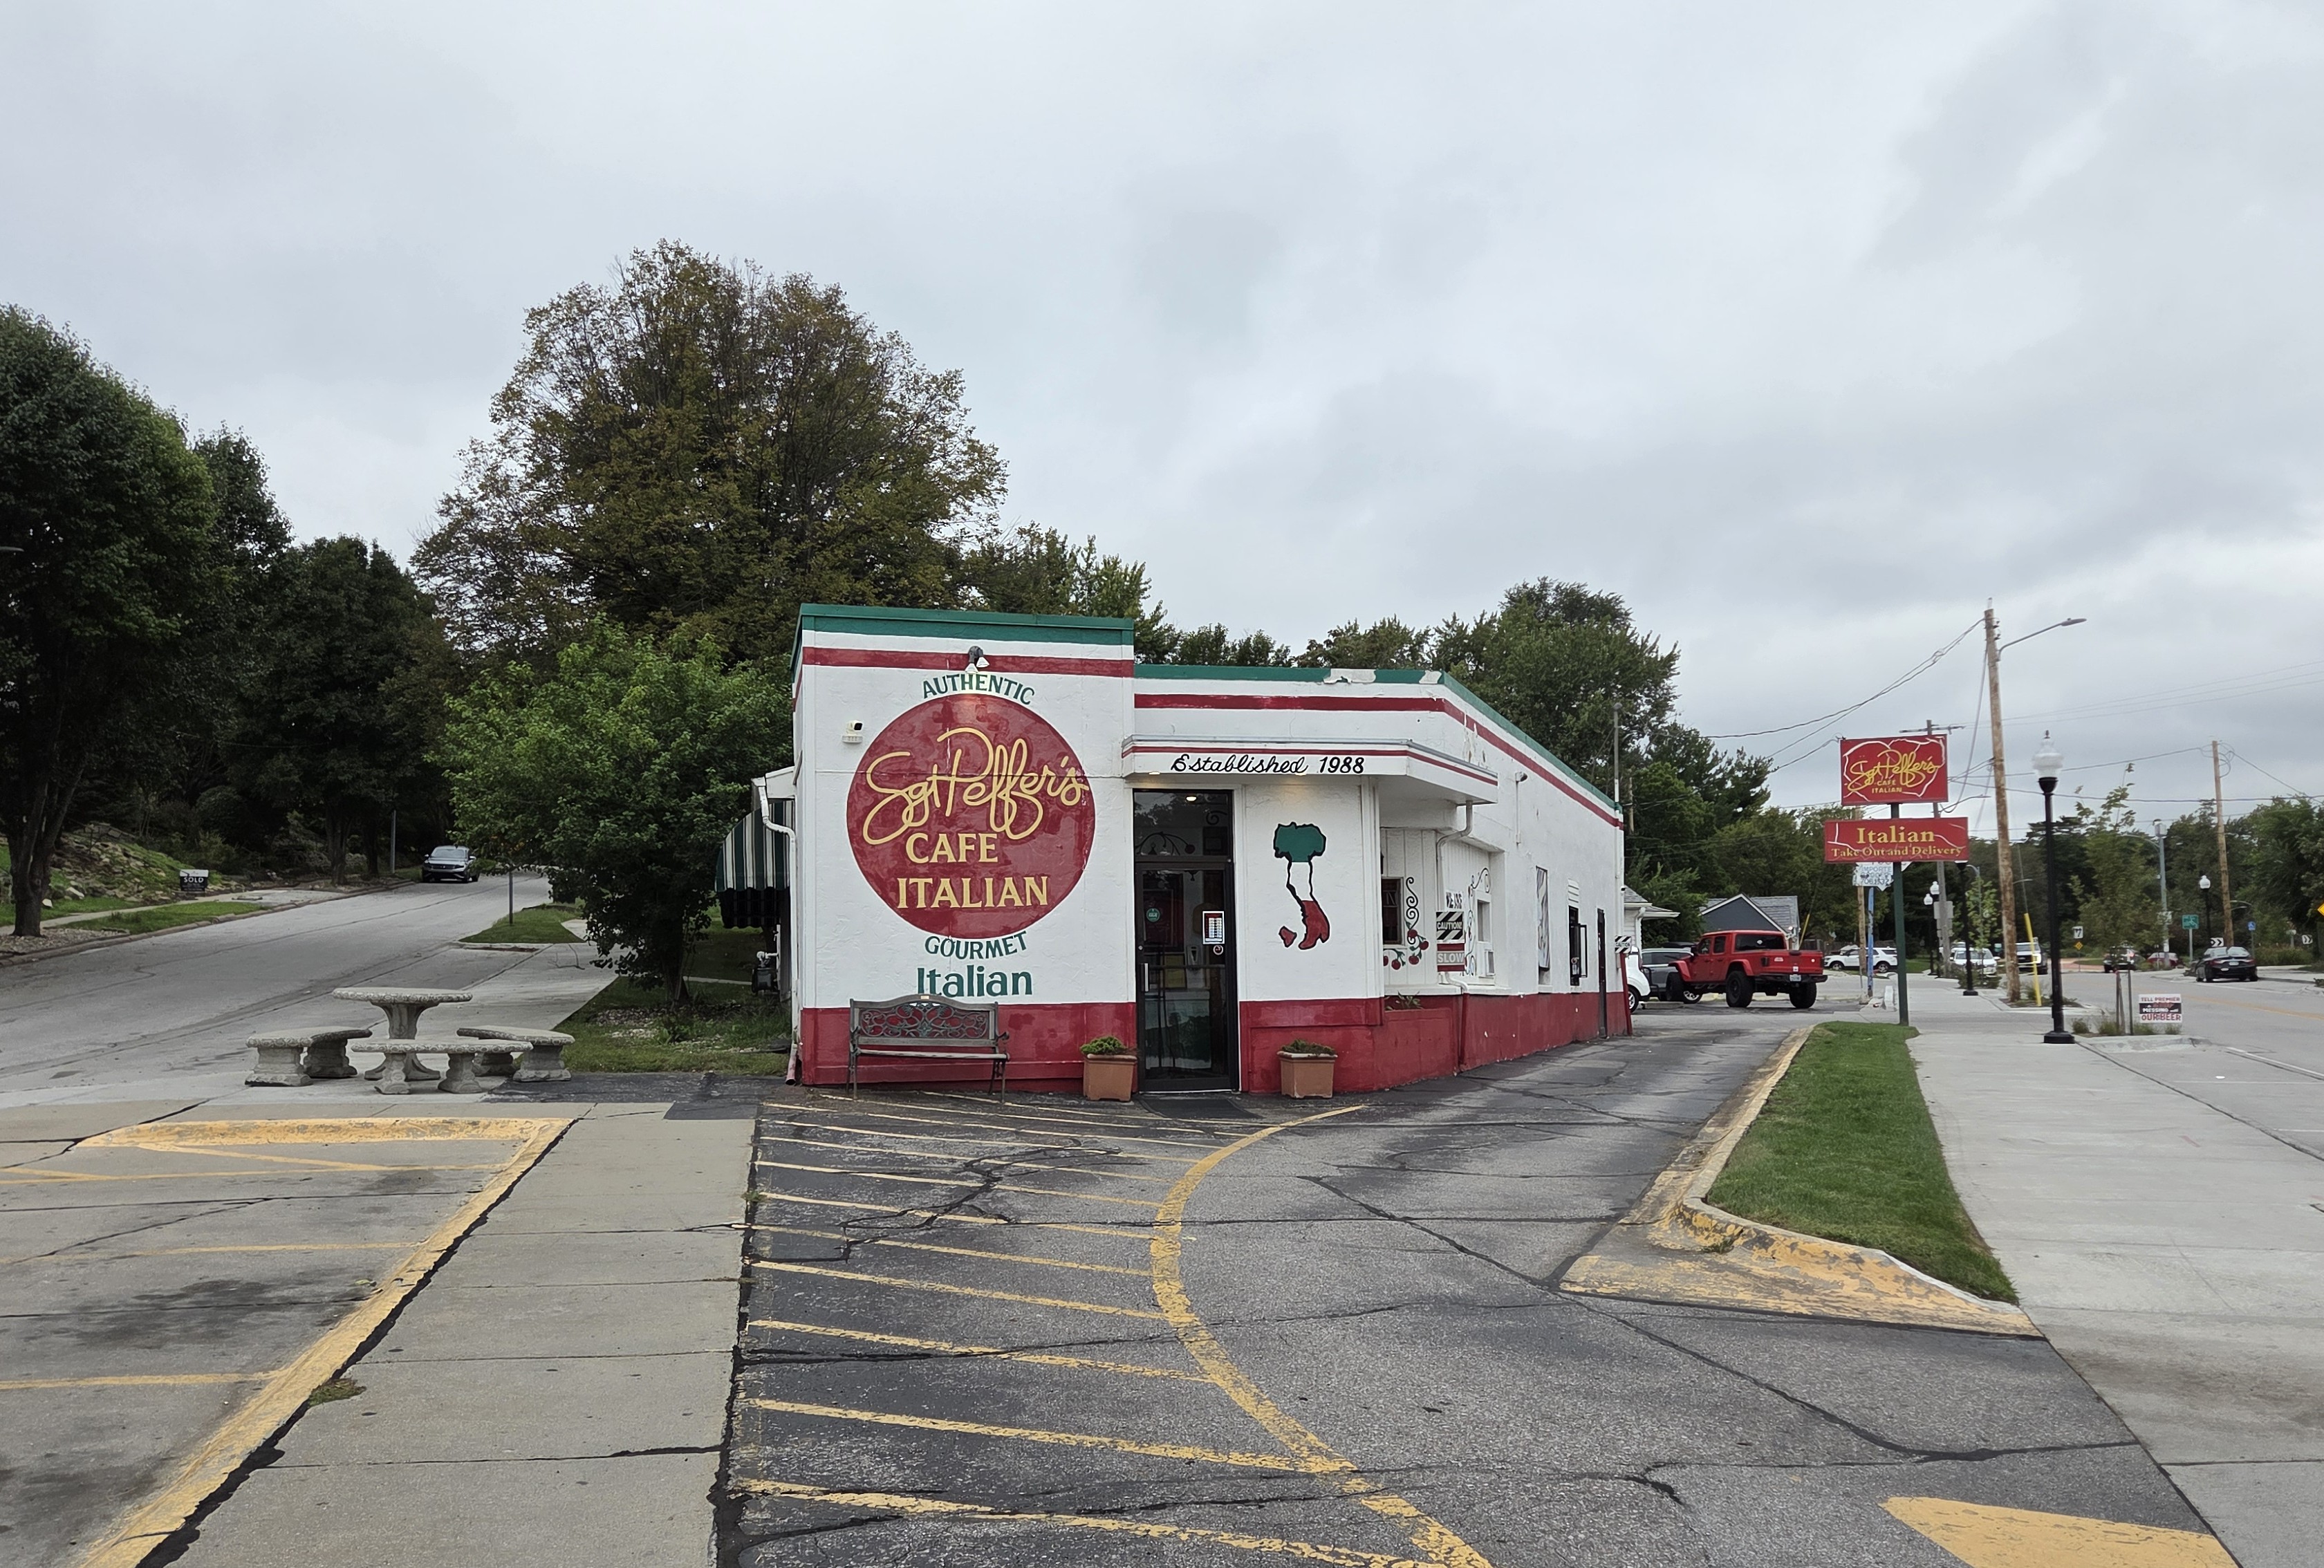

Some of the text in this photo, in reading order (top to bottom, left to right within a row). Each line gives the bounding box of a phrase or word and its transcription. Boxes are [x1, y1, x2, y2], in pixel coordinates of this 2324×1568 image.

[922, 673, 1035, 704] AUTHENTIC
[1171, 754, 1366, 774] Established 1988
[906, 832, 998, 864] CAFE
[1856, 825, 1935, 844] Italian
[1831, 846, 1962, 857] Take Out and Delivery
[897, 876, 1048, 908] ITALIAN
[924, 931, 1028, 960] GOURMET
[1438, 953, 1464, 962] SLOW
[917, 964, 1032, 997] Italian
